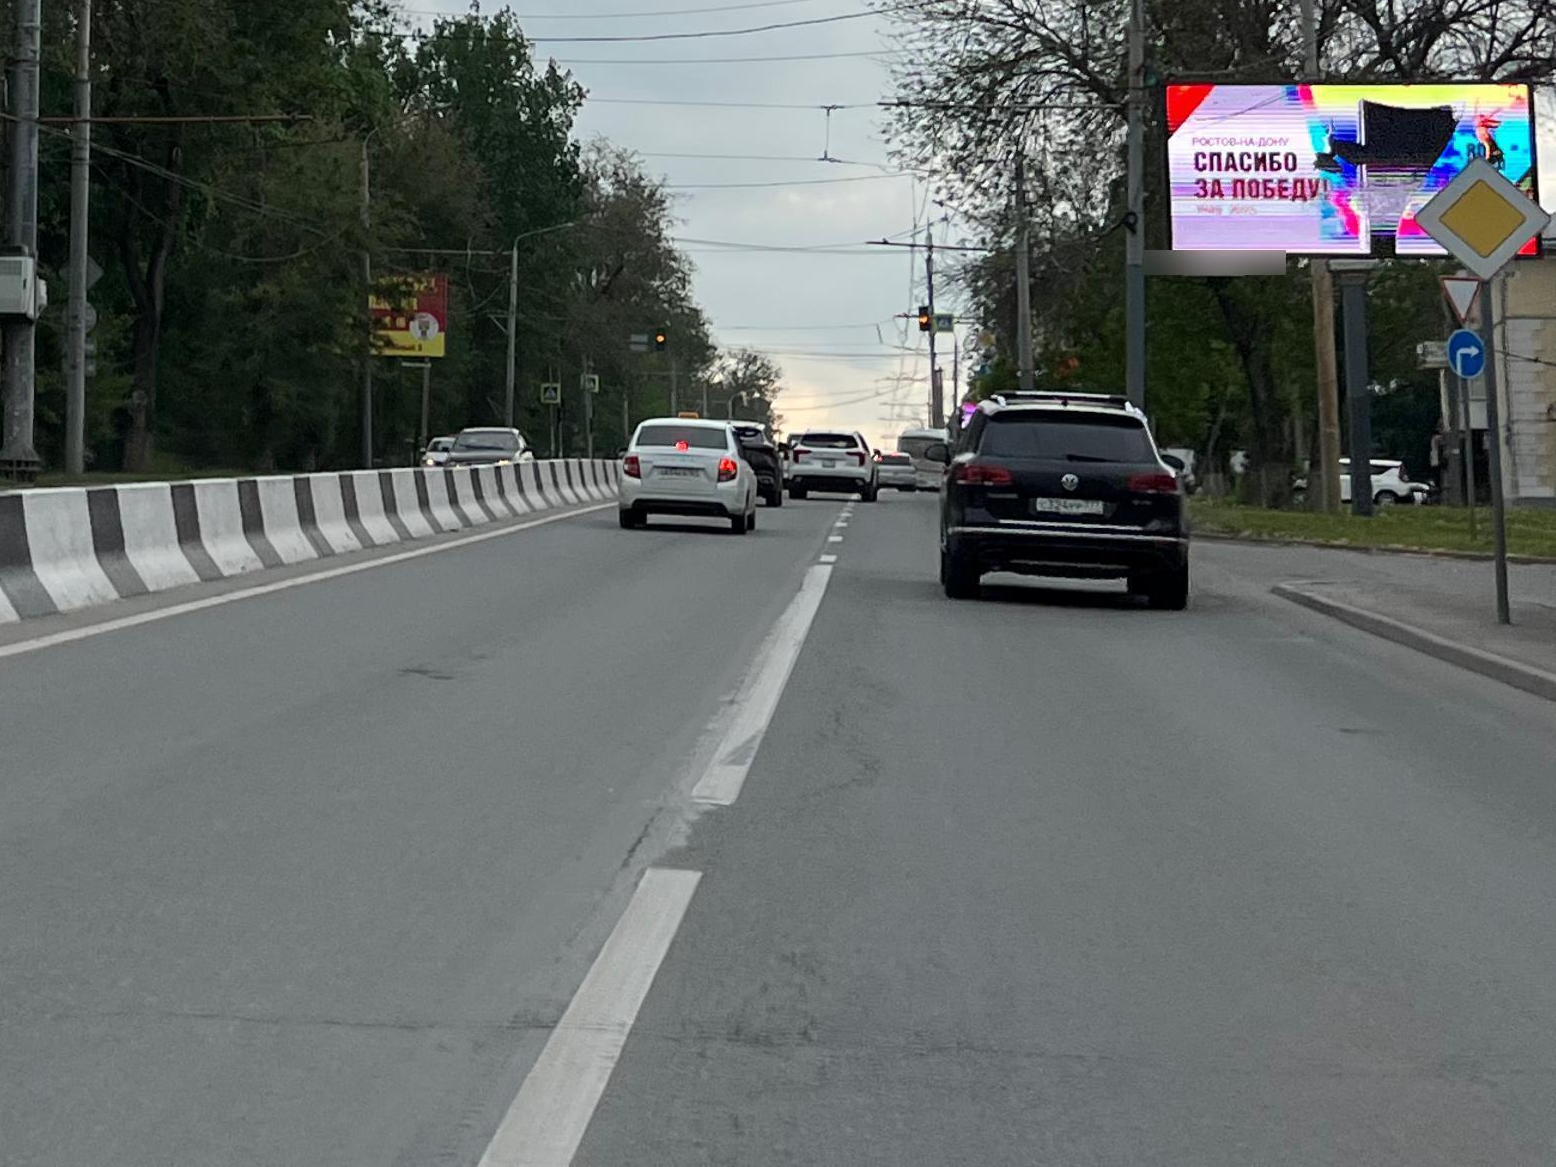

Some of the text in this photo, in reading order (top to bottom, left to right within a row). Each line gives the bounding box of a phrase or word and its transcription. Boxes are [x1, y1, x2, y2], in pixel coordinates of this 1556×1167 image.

[1194, 151, 1297, 172] СПАСИБО
[1194, 177, 1330, 202] ЗА ПОБЕДУ!
